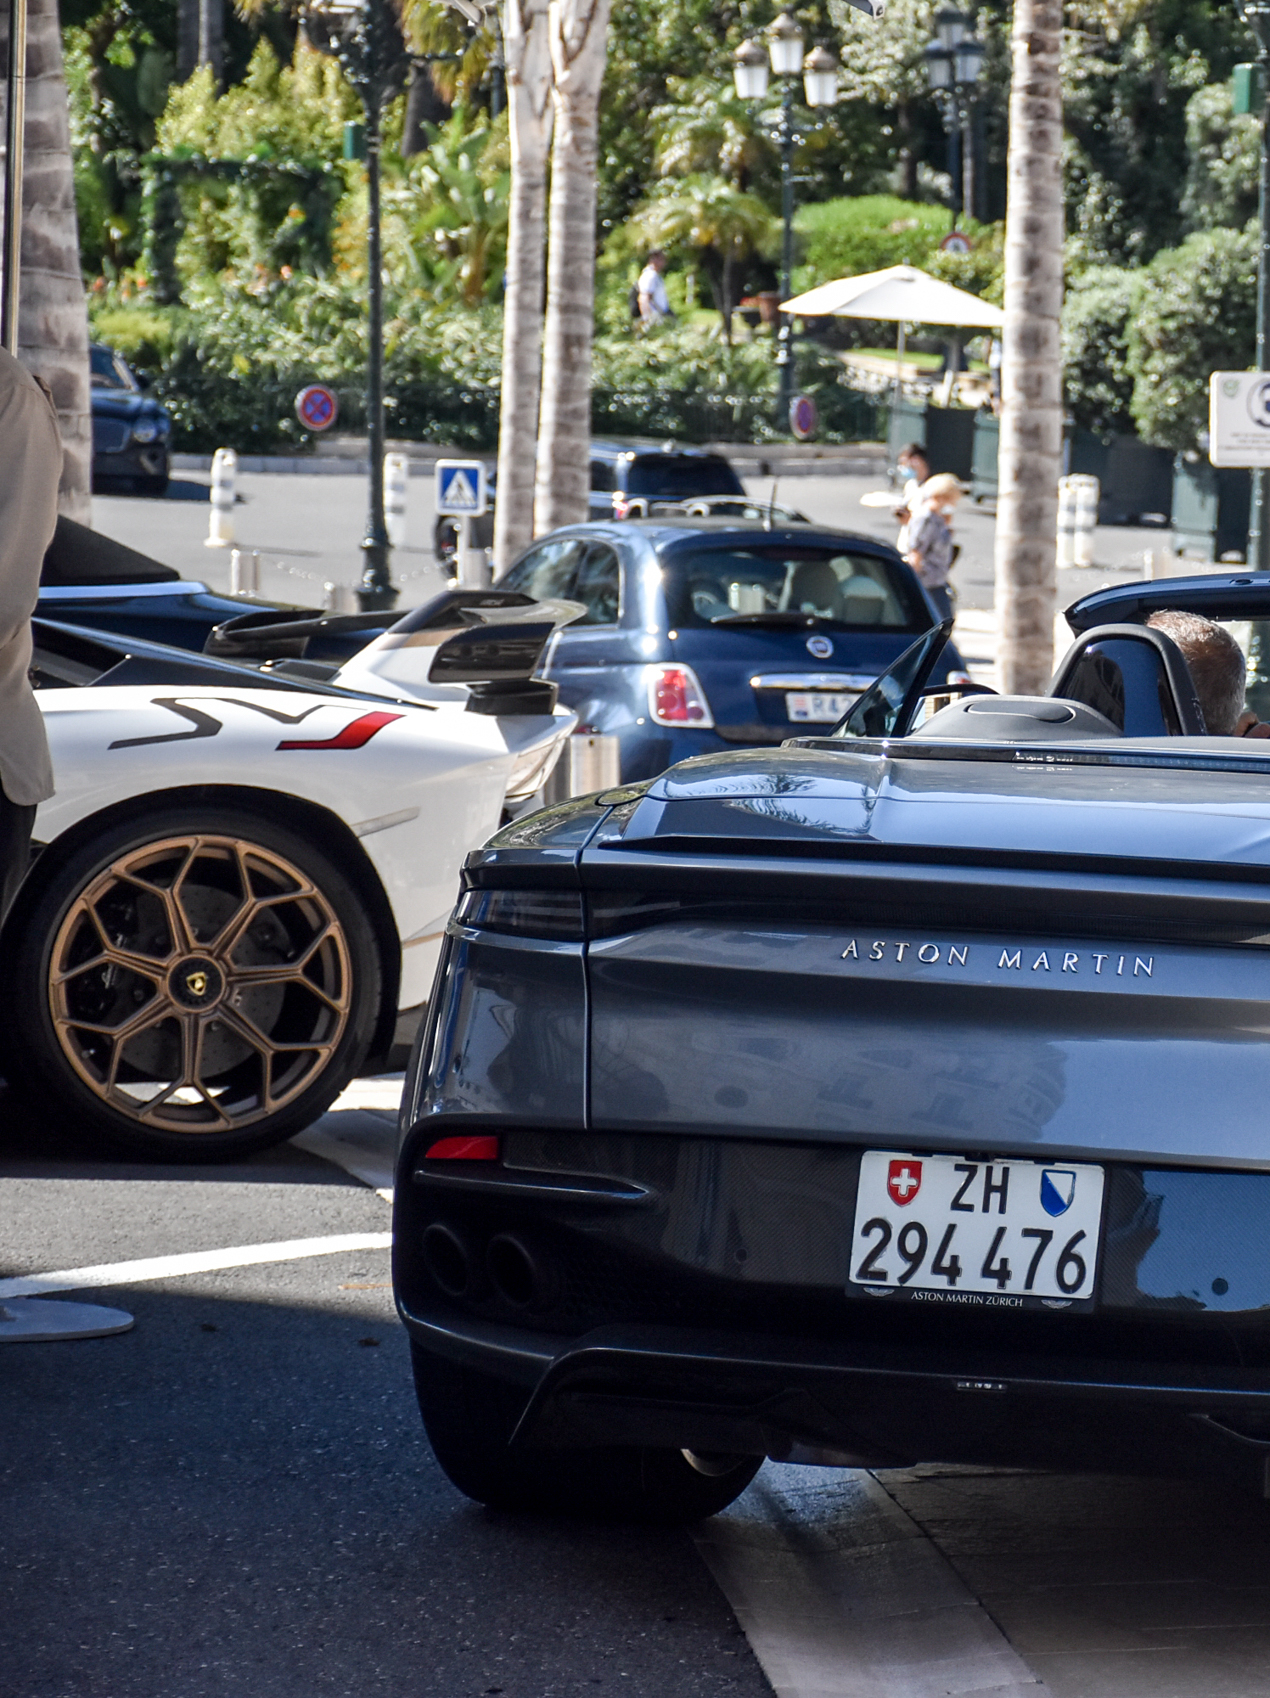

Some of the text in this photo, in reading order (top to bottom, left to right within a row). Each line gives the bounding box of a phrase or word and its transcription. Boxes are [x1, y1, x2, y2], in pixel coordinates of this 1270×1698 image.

[840, 939, 1154, 977] ASTON MARTIN
[950, 1163, 1010, 1214] ZH
[856, 1217, 1087, 1295] 294 476
[911, 1291, 1023, 1307] ASTON MARTIN ZÜRICH
